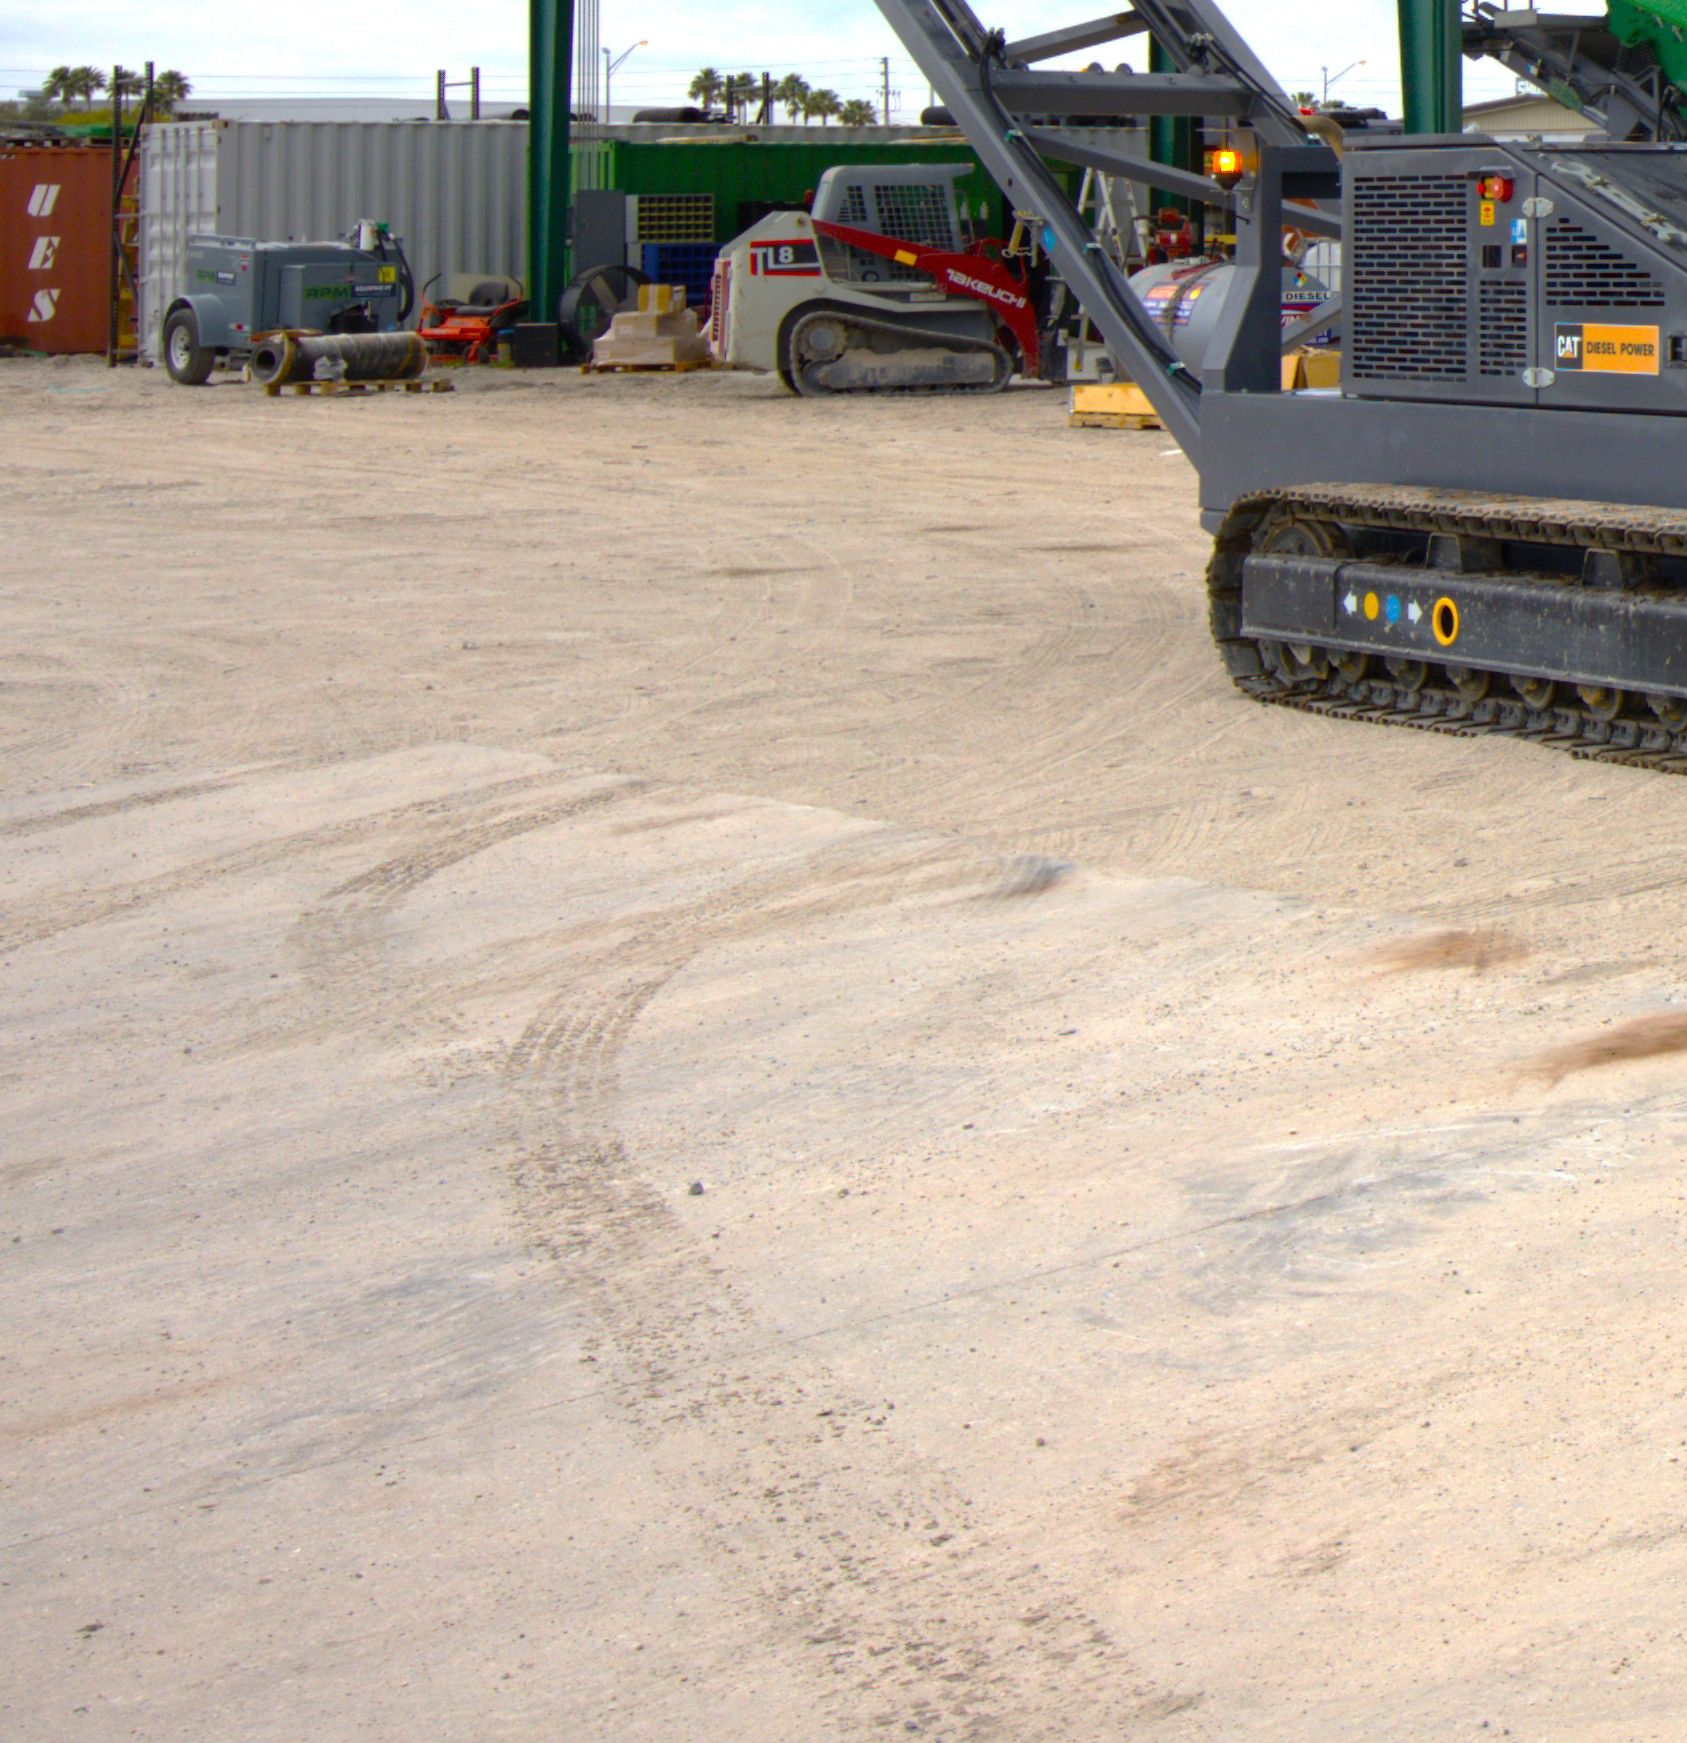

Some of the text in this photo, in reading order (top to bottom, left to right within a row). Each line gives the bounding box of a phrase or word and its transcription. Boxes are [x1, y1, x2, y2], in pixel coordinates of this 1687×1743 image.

[1285, 292, 1331, 301] DIESEL
[1557, 335, 1654, 358] CAT DIESEL POWER
